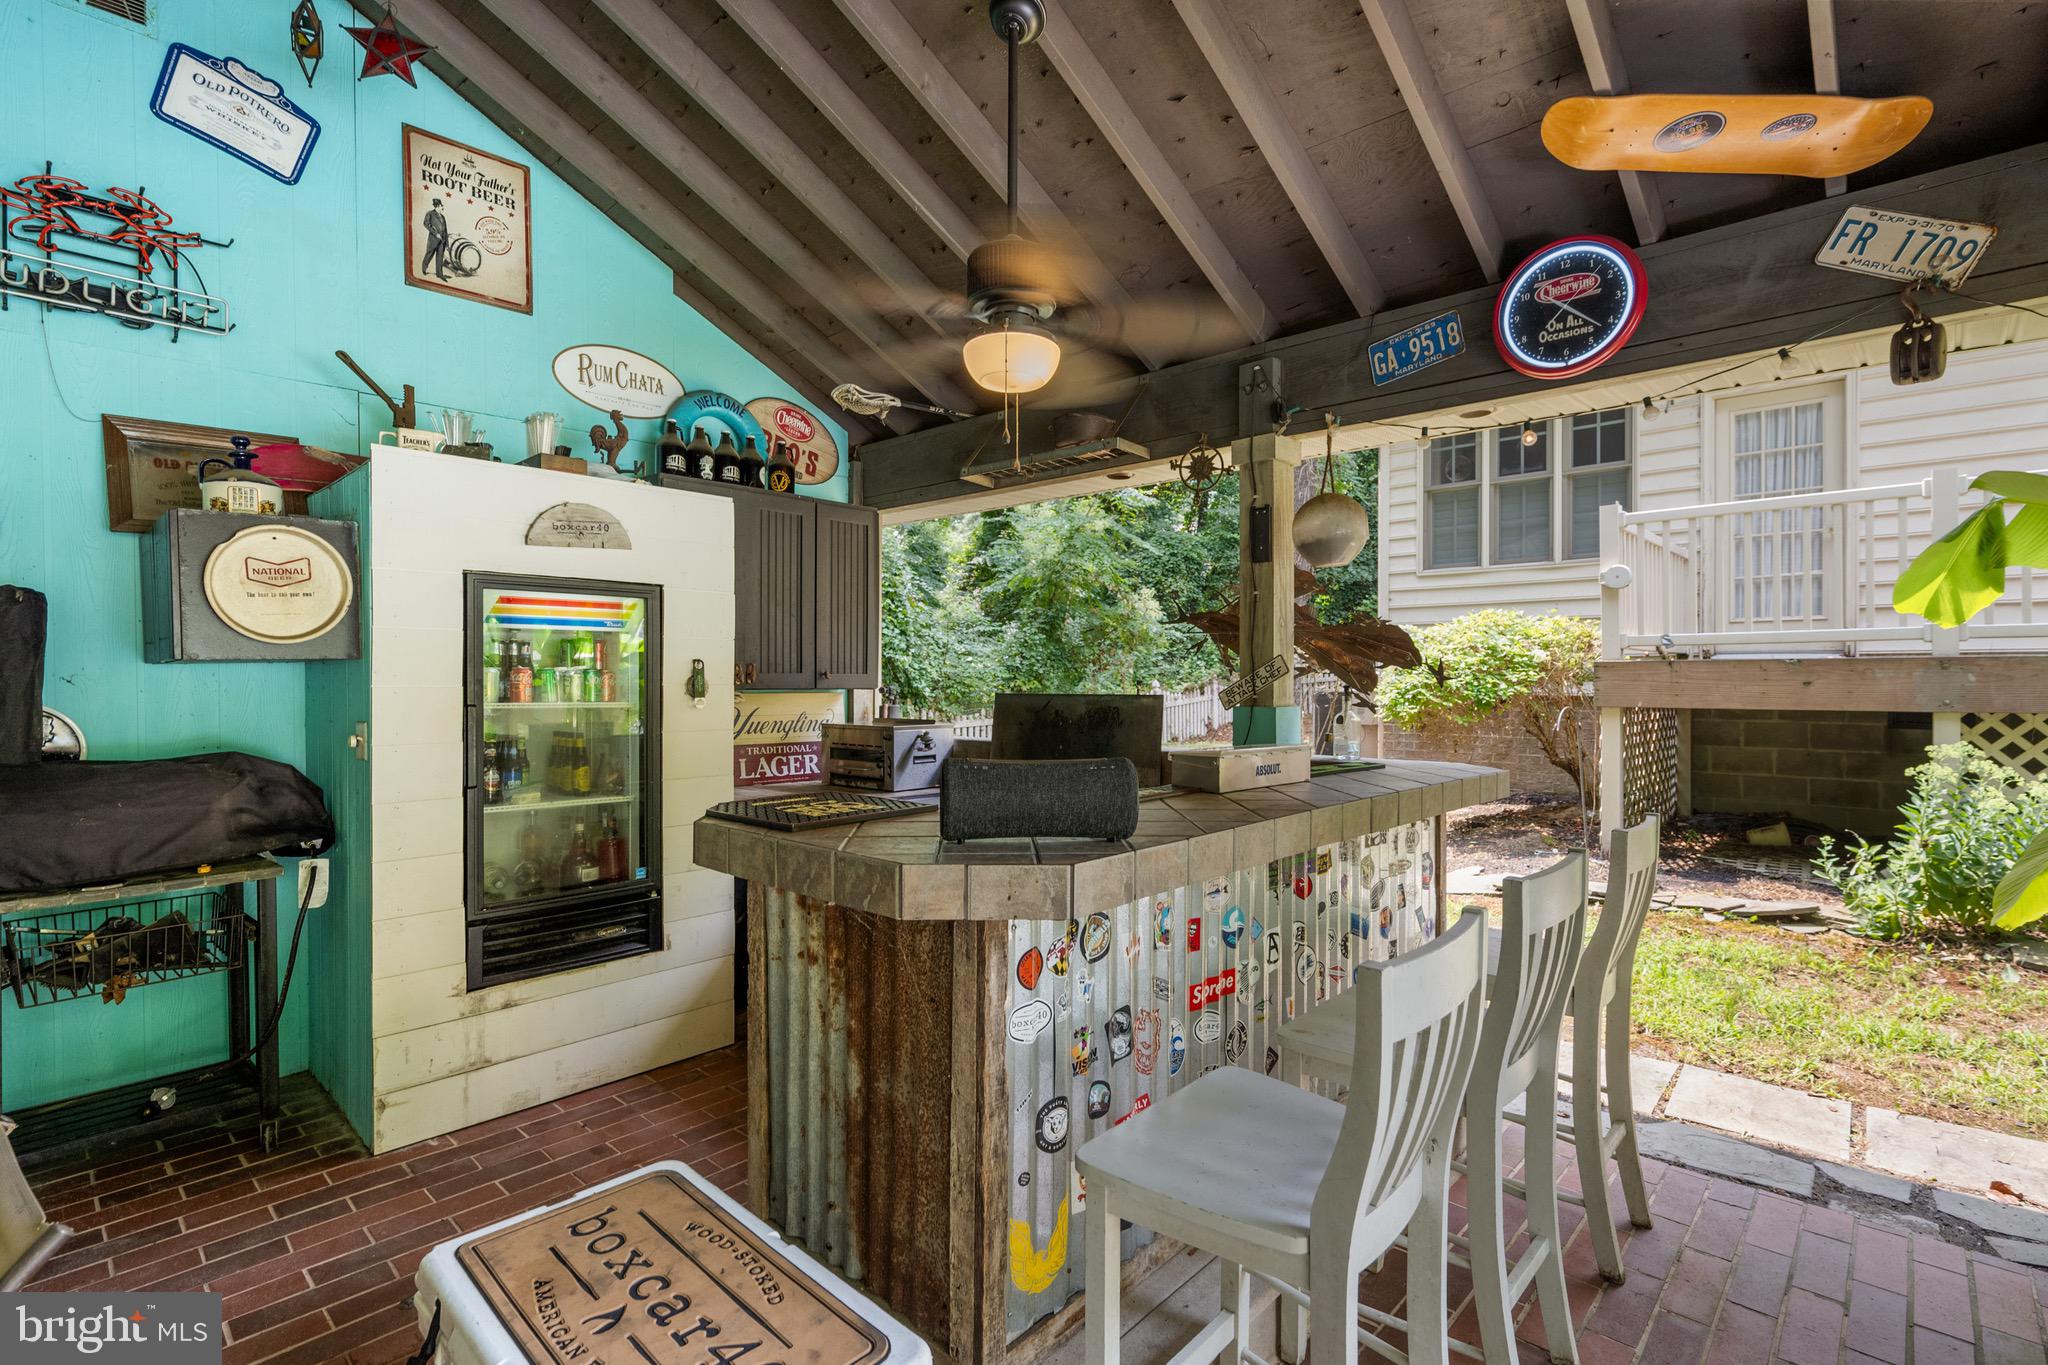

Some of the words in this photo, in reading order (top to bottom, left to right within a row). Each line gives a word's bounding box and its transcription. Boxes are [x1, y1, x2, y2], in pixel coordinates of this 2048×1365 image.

[193, 72, 226, 94] OLD
[229, 86, 291, 135] POTRERO
[420, 153, 442, 170] Not
[444, 161, 472, 182] Your
[474, 171, 516, 196] Father's
[421, 168, 468, 194] ROOT
[471, 185, 516, 211] BEER
[1829, 219, 1879, 256] FR
[1560, 259, 1571, 270] 12
[1590, 259, 1594, 268] 1
[1849, 257, 1927, 279] MARYLAND
[1537, 271, 1547, 281] 11
[1607, 270, 1614, 278] 2
[1540, 277, 1595, 301] Cheerwine
[1615, 290, 1621, 299] 3
[82, 276, 219, 328] LIGHT
[1520, 293, 1530, 302] 10
[1514, 315, 1520, 324] 9
[1566, 315, 1584, 328] ALL
[1607, 314, 1614, 324] 4
[1521, 335, 1527, 344] 8
[1539, 325, 1594, 343] OCCASIONS
[1588, 336, 1594, 345] 5
[1539, 347, 1544, 355] 7
[1563, 348, 1569, 356] 6
[1395, 353, 1443, 376] MARYLAND
[693, 394, 746, 418] WELCOME
[776, 410, 811, 437] Cheerwine
[402, 435, 431, 447] TEACHER'S
[153, 457, 181, 470] OLD
[552, 522, 610, 533] boxcar40
[252, 567, 306, 576] NATIONAL
[1225, 670, 1262, 698] BEWARE
[1264, 660, 1276, 674] OF
[1228, 683, 1259, 707] ATTACK
[1260, 665, 1282, 686] CHEF
[734, 706, 835, 741] Yuengling
[746, 744, 812, 756] TRADITIONAL
[738, 754, 821, 779] LAGER
[566, 1205, 784, 1365] boxcar4
[532, 1278, 590, 1359] AMERICAN
